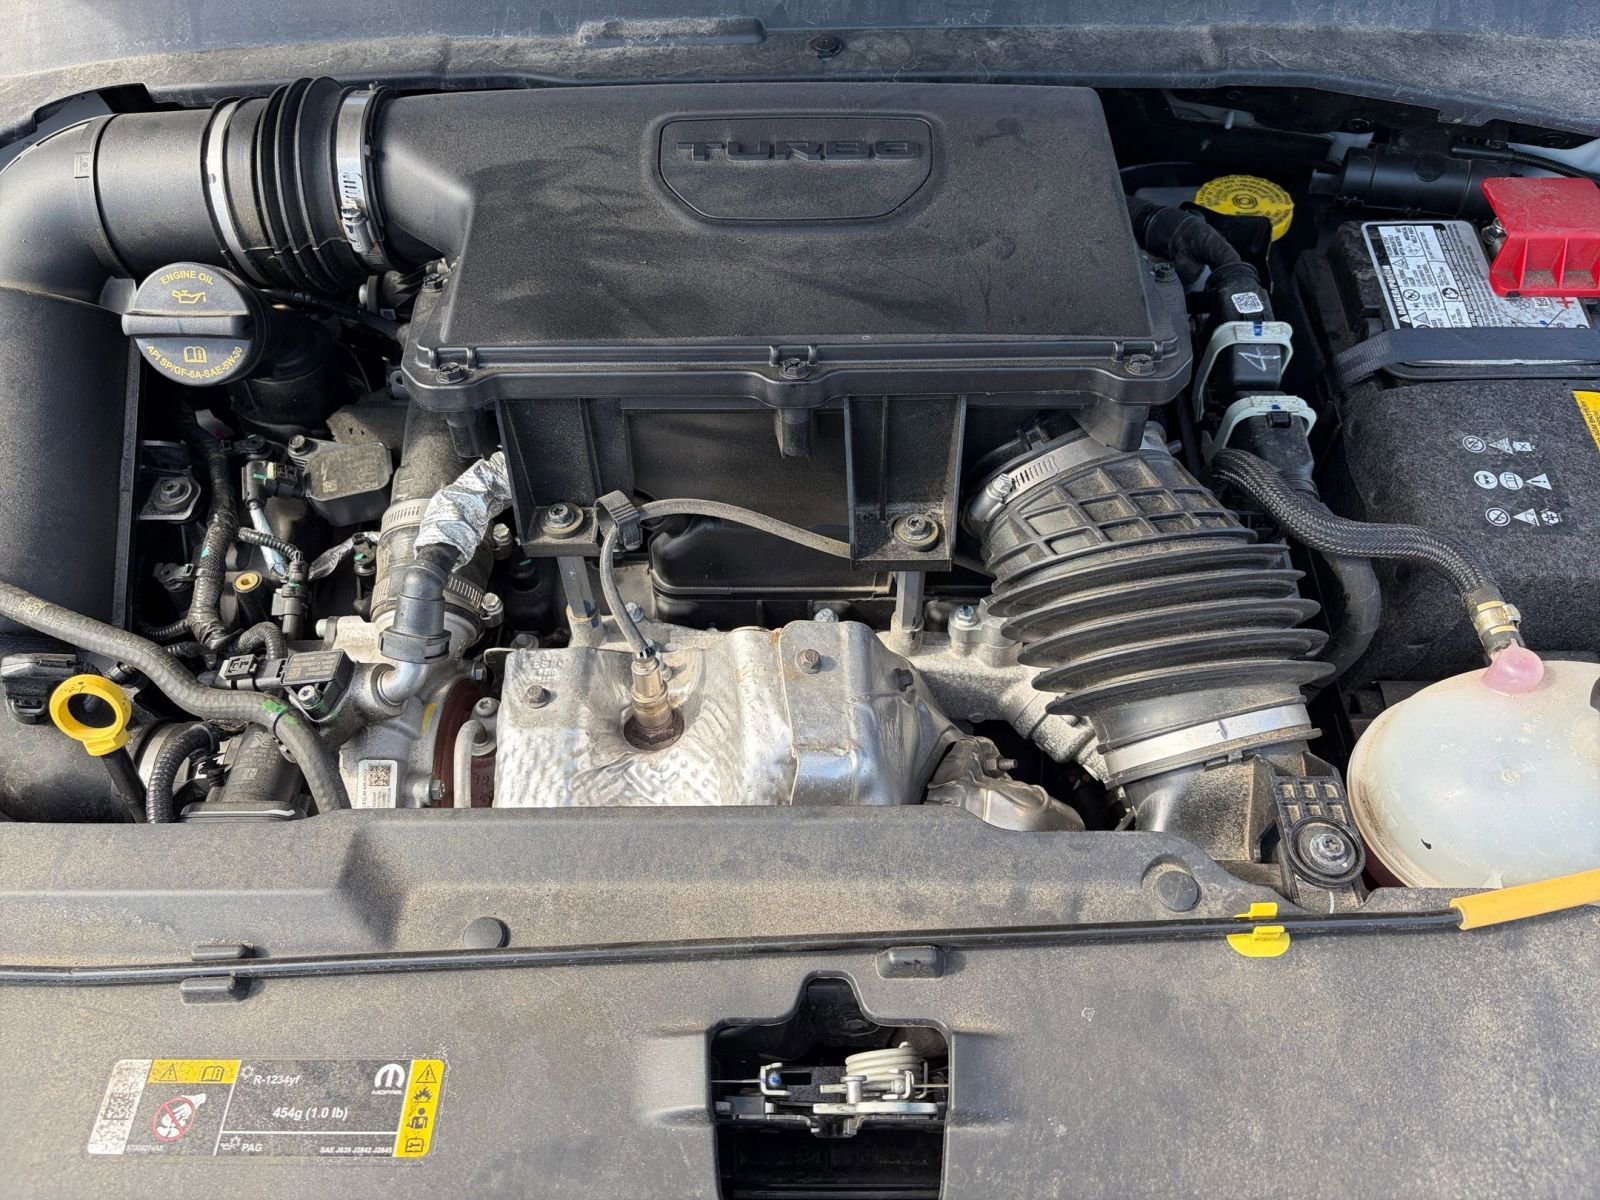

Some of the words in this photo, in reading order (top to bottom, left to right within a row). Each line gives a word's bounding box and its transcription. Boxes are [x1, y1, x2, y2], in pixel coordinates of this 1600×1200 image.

[676, 141, 920, 161] TURBO
[160, 270, 197, 285] ENGINE
[199, 272, 214, 285] OIL
[146, 345, 161, 361] API
[253, 1074, 301, 1087] R-1234yf
[272, 1107, 303, 1121] 454g
[305, 1107, 330, 1121] (1.0
[331, 1107, 349, 1121] lb)
[242, 1143, 263, 1152] PAG
[319, 1146, 335, 1154] SAE
